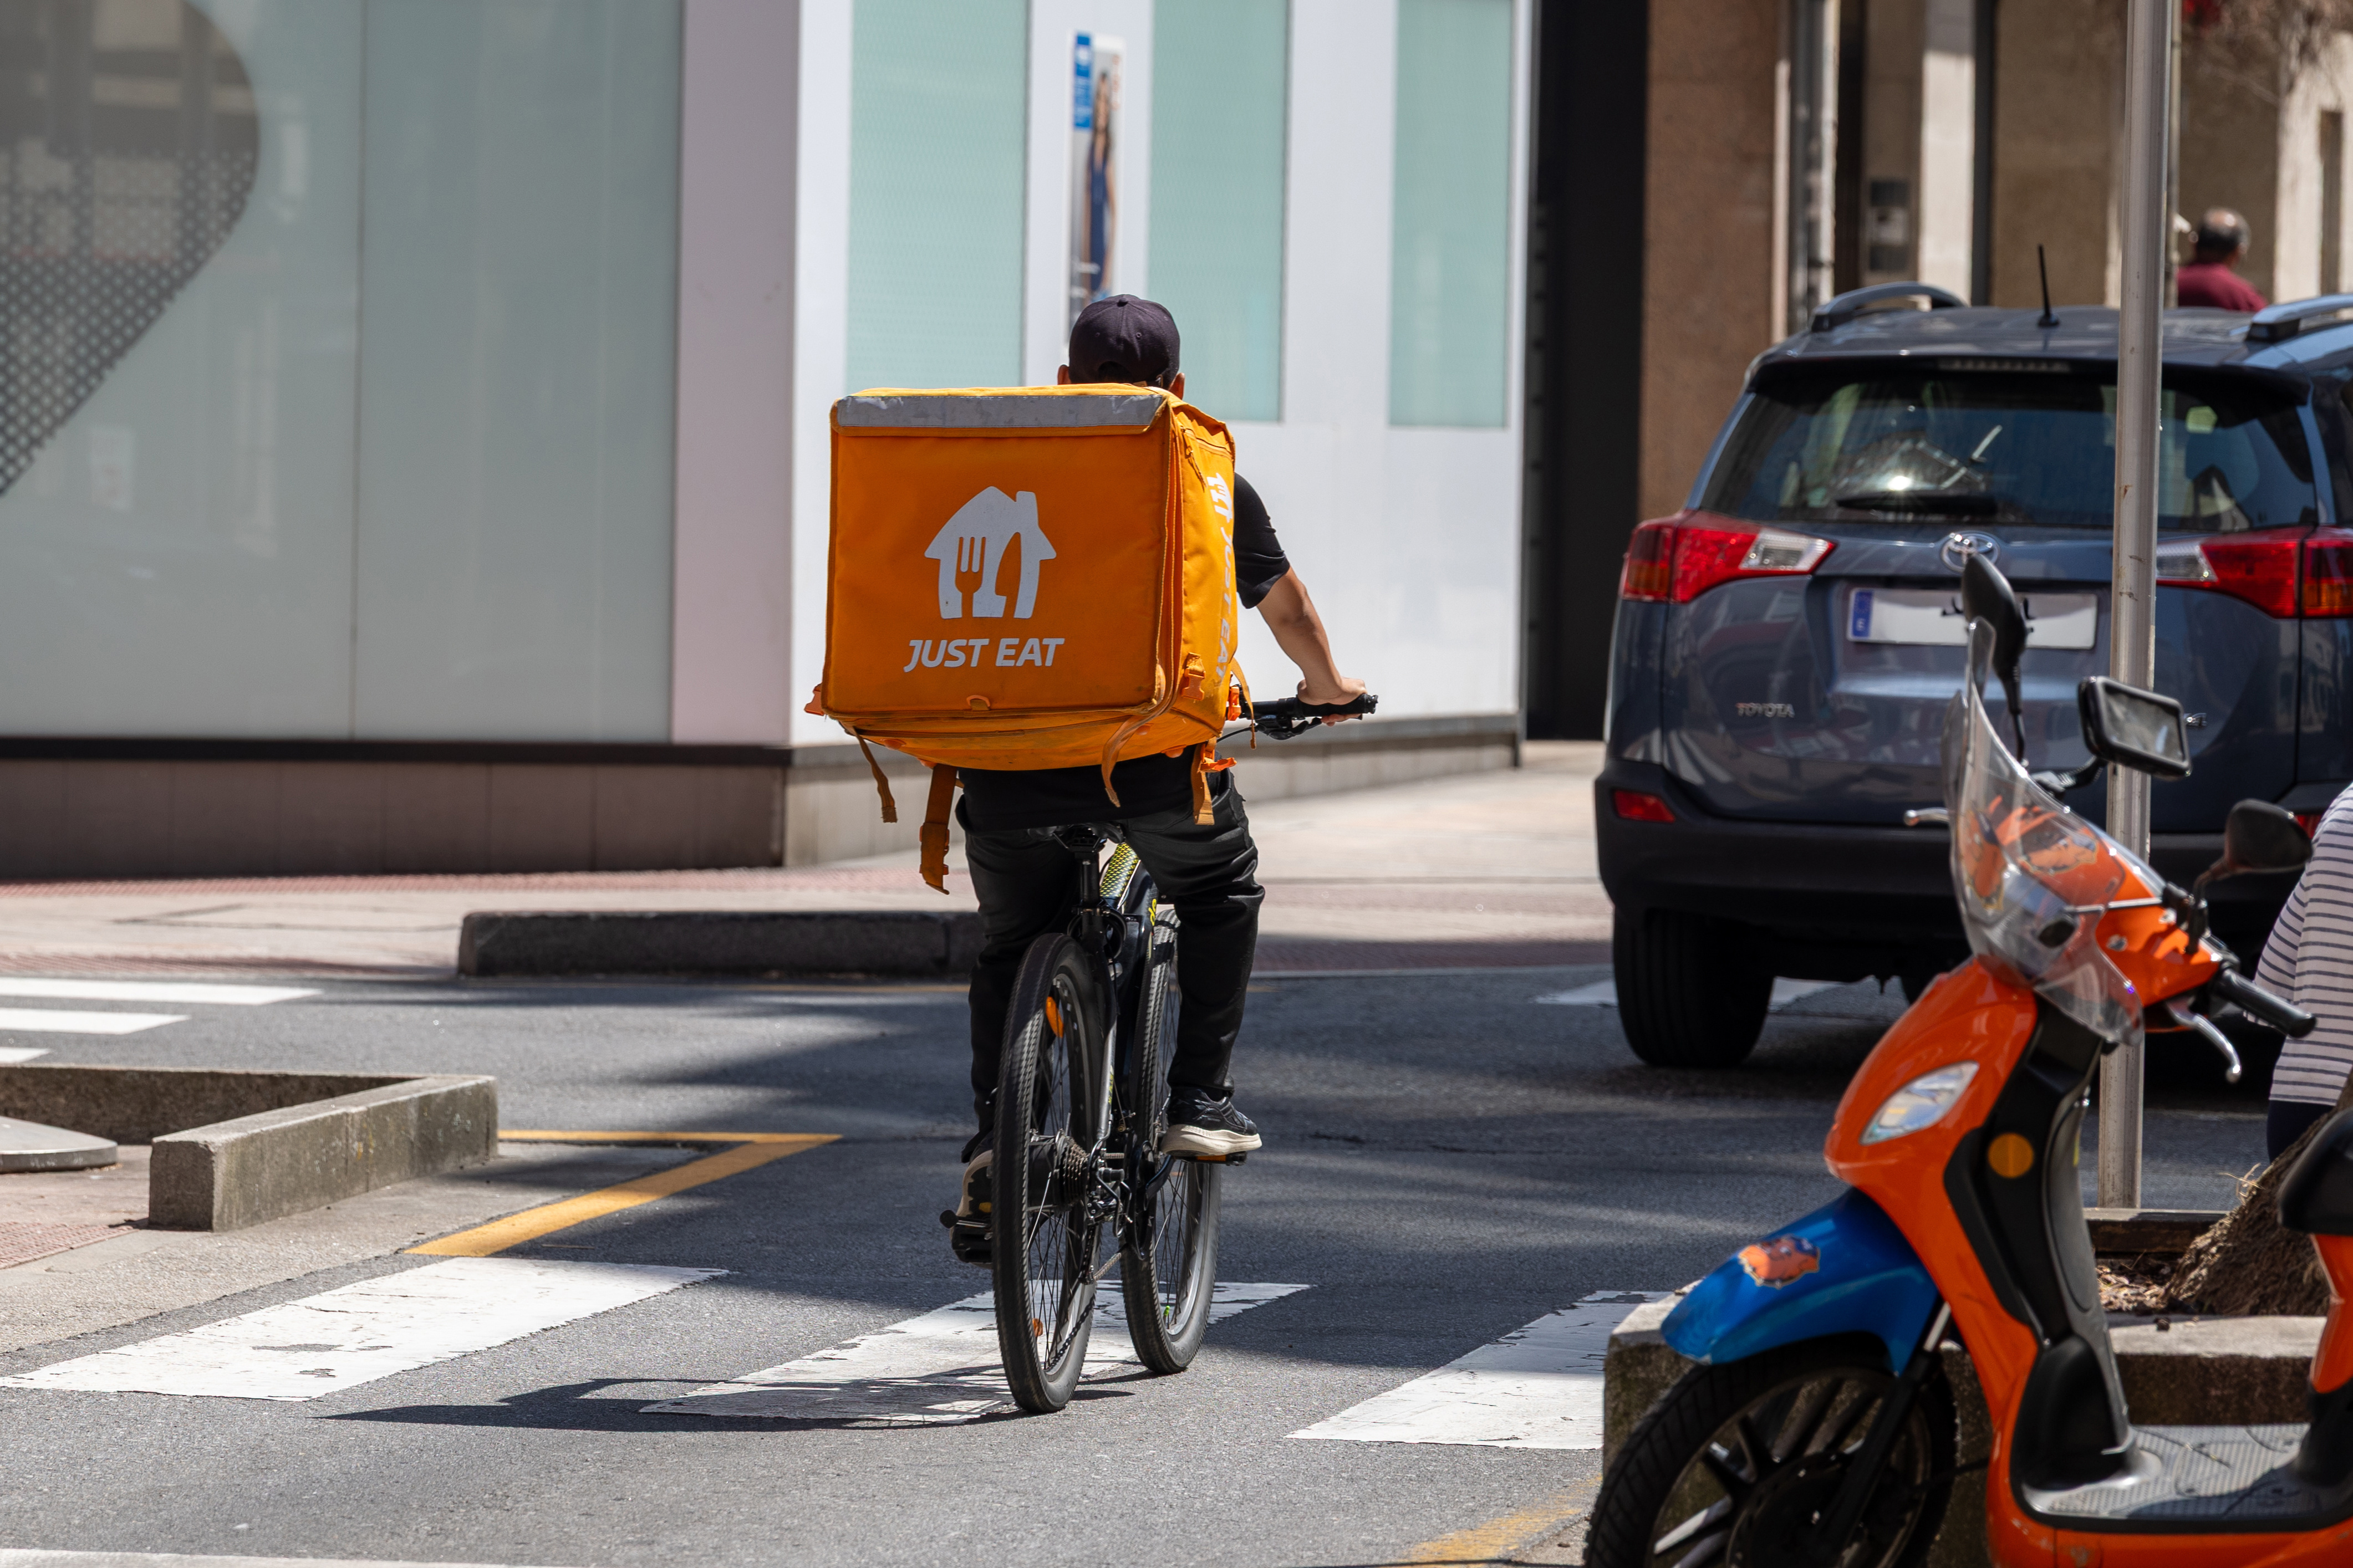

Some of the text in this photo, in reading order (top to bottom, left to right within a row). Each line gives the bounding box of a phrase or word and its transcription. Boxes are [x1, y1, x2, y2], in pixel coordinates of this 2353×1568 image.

[1216, 527, 1232, 680] JUST EAT
[903, 638, 1065, 673] JUST EAT
[1735, 702, 1795, 718] TOYOTA
